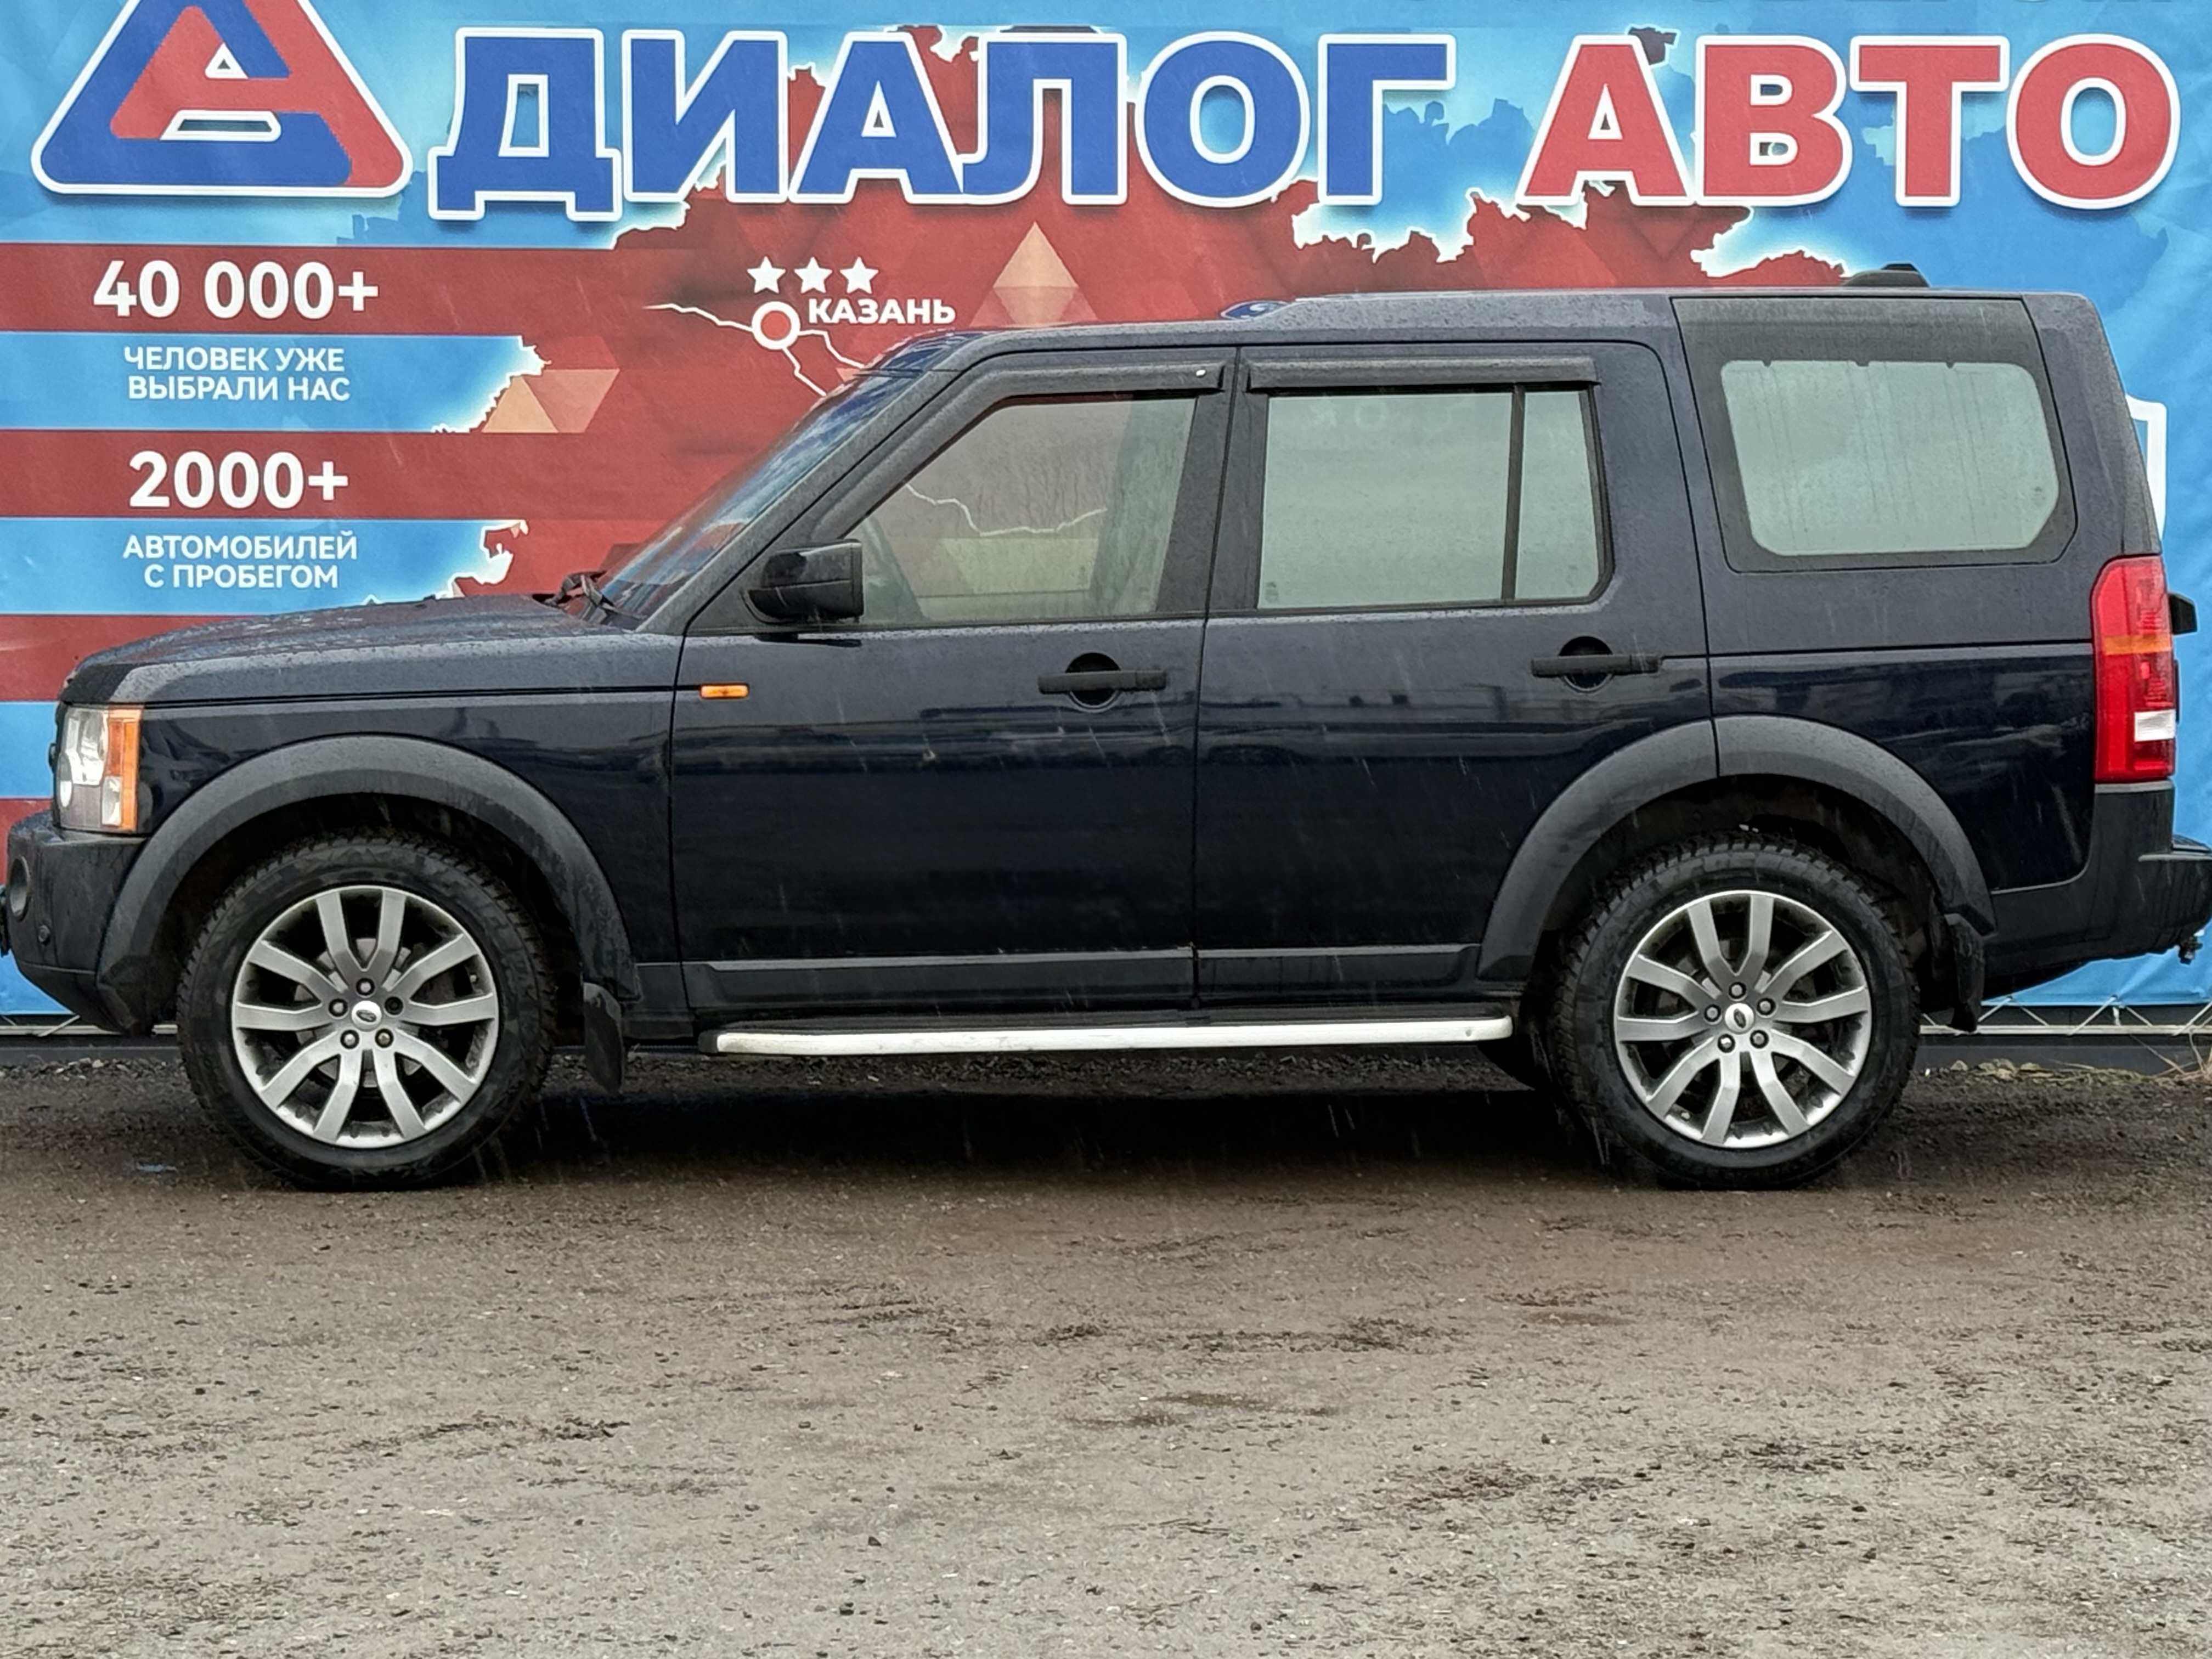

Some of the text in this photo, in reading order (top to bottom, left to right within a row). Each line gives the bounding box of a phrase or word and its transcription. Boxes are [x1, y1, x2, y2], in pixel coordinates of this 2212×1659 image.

[427, 27, 2181, 222] ДИАЛОГ АВТО
[93, 260, 379, 319] 40 000+
[808, 298, 956, 324] КАЗАНЬ
[123, 347, 345, 373] ЧЕЛОВЕК УЖЕ
[128, 377, 351, 402] ВЫБРАЛИ НАС
[129, 451, 348, 509] 2000+
[123, 531, 357, 559] АВТОМОБИЛЕЙ
[144, 565, 338, 589] С ПРОБЕГОМ
